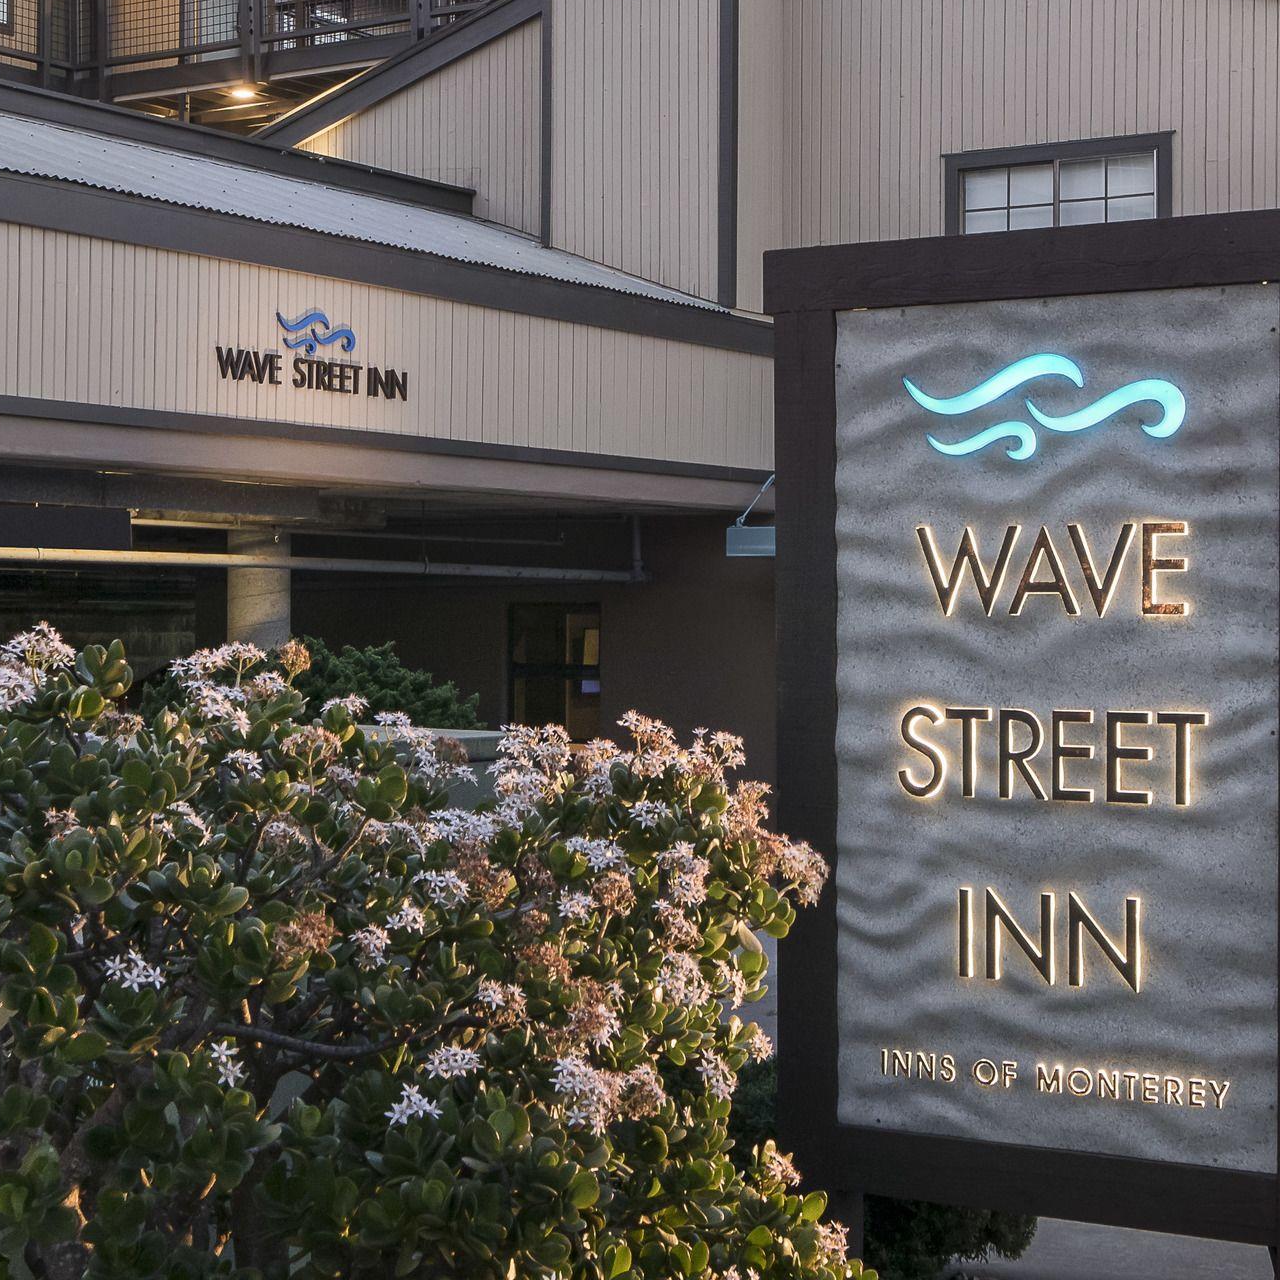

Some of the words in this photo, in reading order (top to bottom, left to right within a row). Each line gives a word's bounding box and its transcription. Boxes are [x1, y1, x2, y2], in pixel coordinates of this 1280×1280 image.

[215, 346, 282, 385] WAVE
[292, 357, 363, 395] STREET
[367, 366, 408, 401] INN
[915, 521, 1189, 618] WAVE
[898, 704, 1209, 806] STREET
[959, 886, 1141, 994] INN
[881, 1048, 956, 1083] INNS
[973, 1058, 1018, 1088] OF
[1036, 1063, 1231, 1110] MONTEREY
